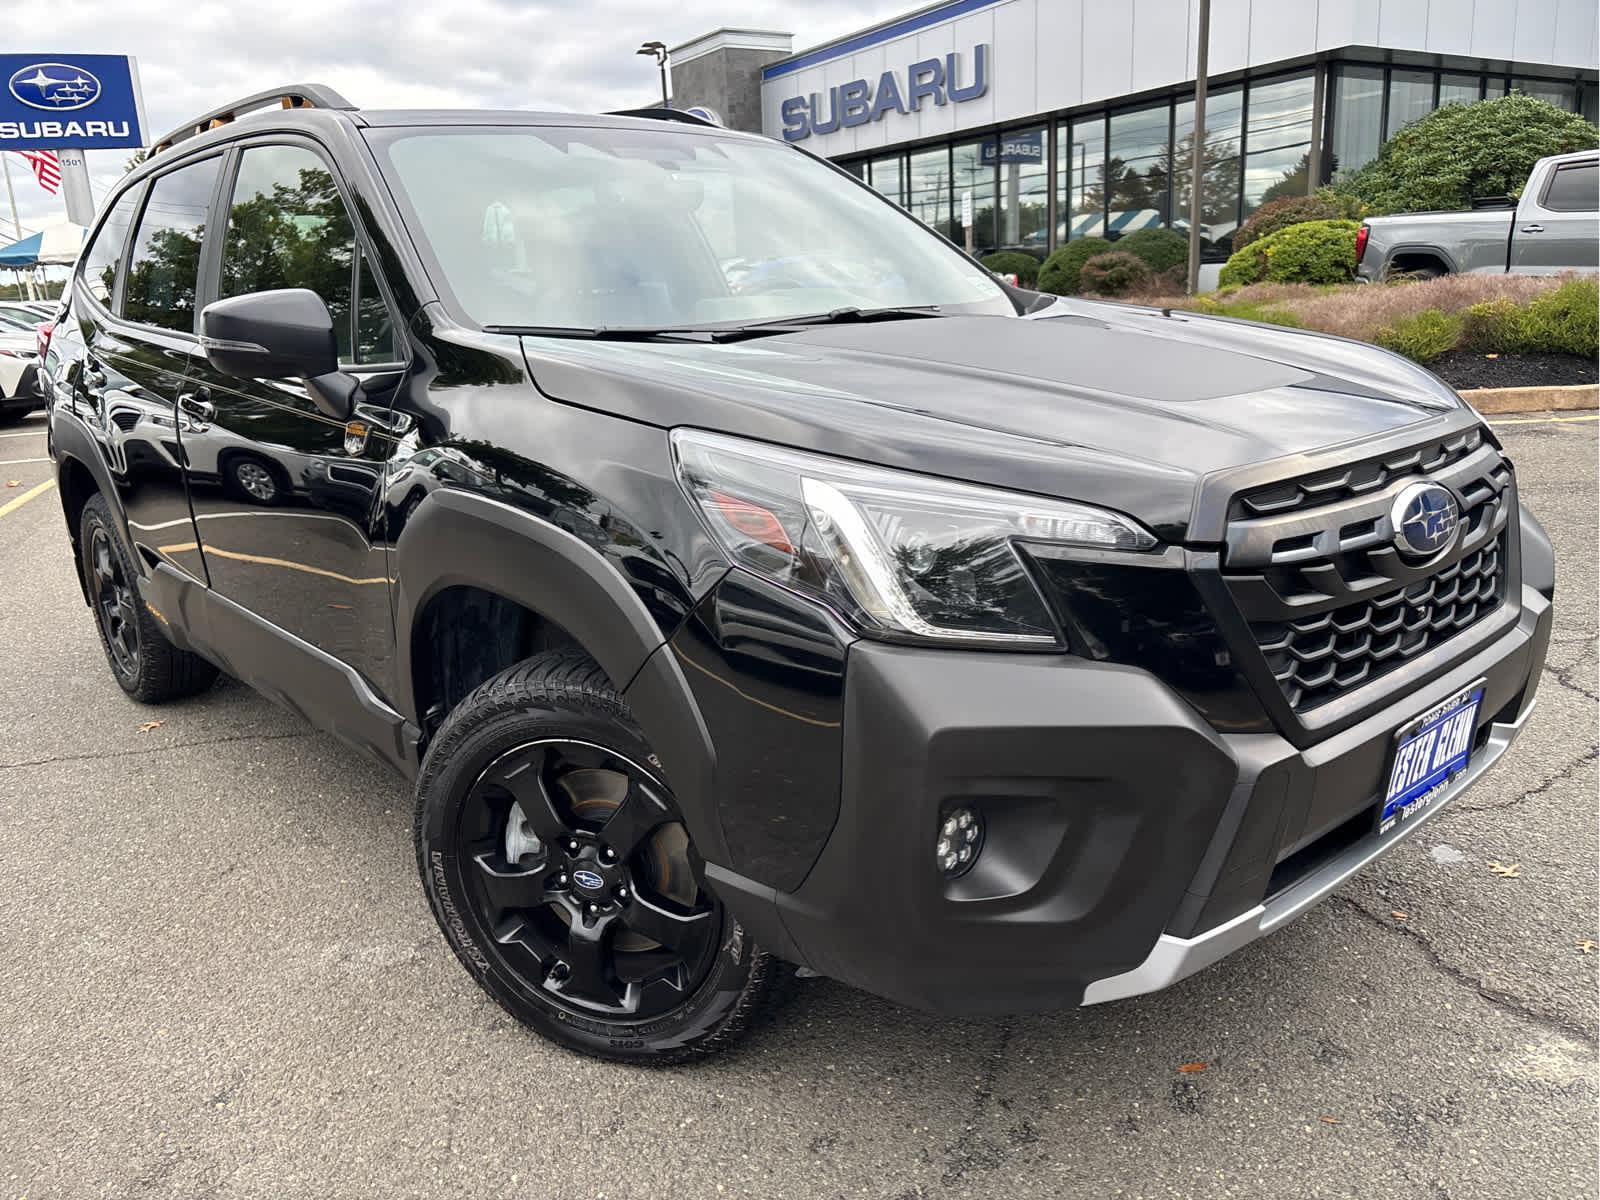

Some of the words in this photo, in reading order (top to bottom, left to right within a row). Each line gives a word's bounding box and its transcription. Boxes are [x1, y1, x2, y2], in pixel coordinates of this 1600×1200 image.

[781, 43, 988, 141] SUBARU
[0, 121, 129, 138] SUBARU
[61, 159, 82, 167] 1501
[1386, 729, 1438, 801] LESTER
[1432, 703, 1477, 770] GLENN
